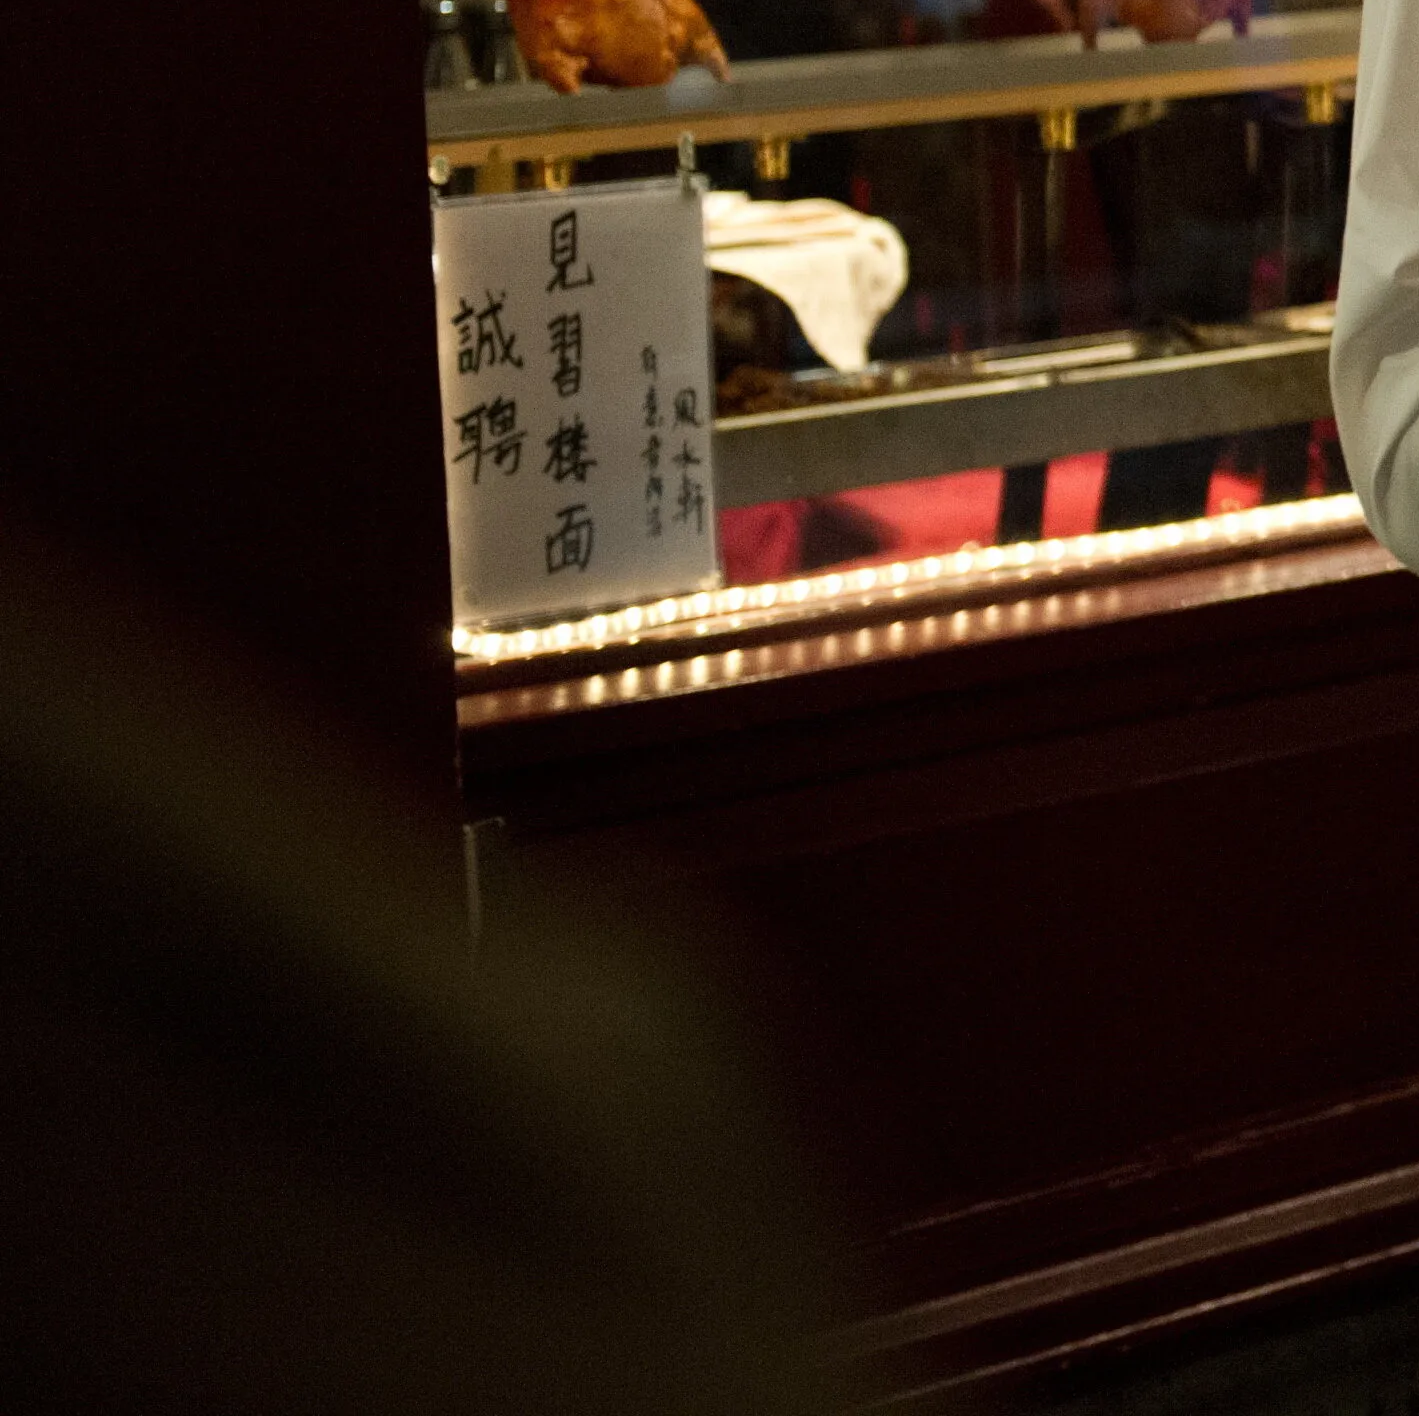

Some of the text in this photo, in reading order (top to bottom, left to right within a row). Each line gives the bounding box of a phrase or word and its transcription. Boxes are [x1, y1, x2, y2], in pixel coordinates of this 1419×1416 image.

[450, 287, 529, 485] 誠聘
[544, 208, 598, 575] 見習樓面
